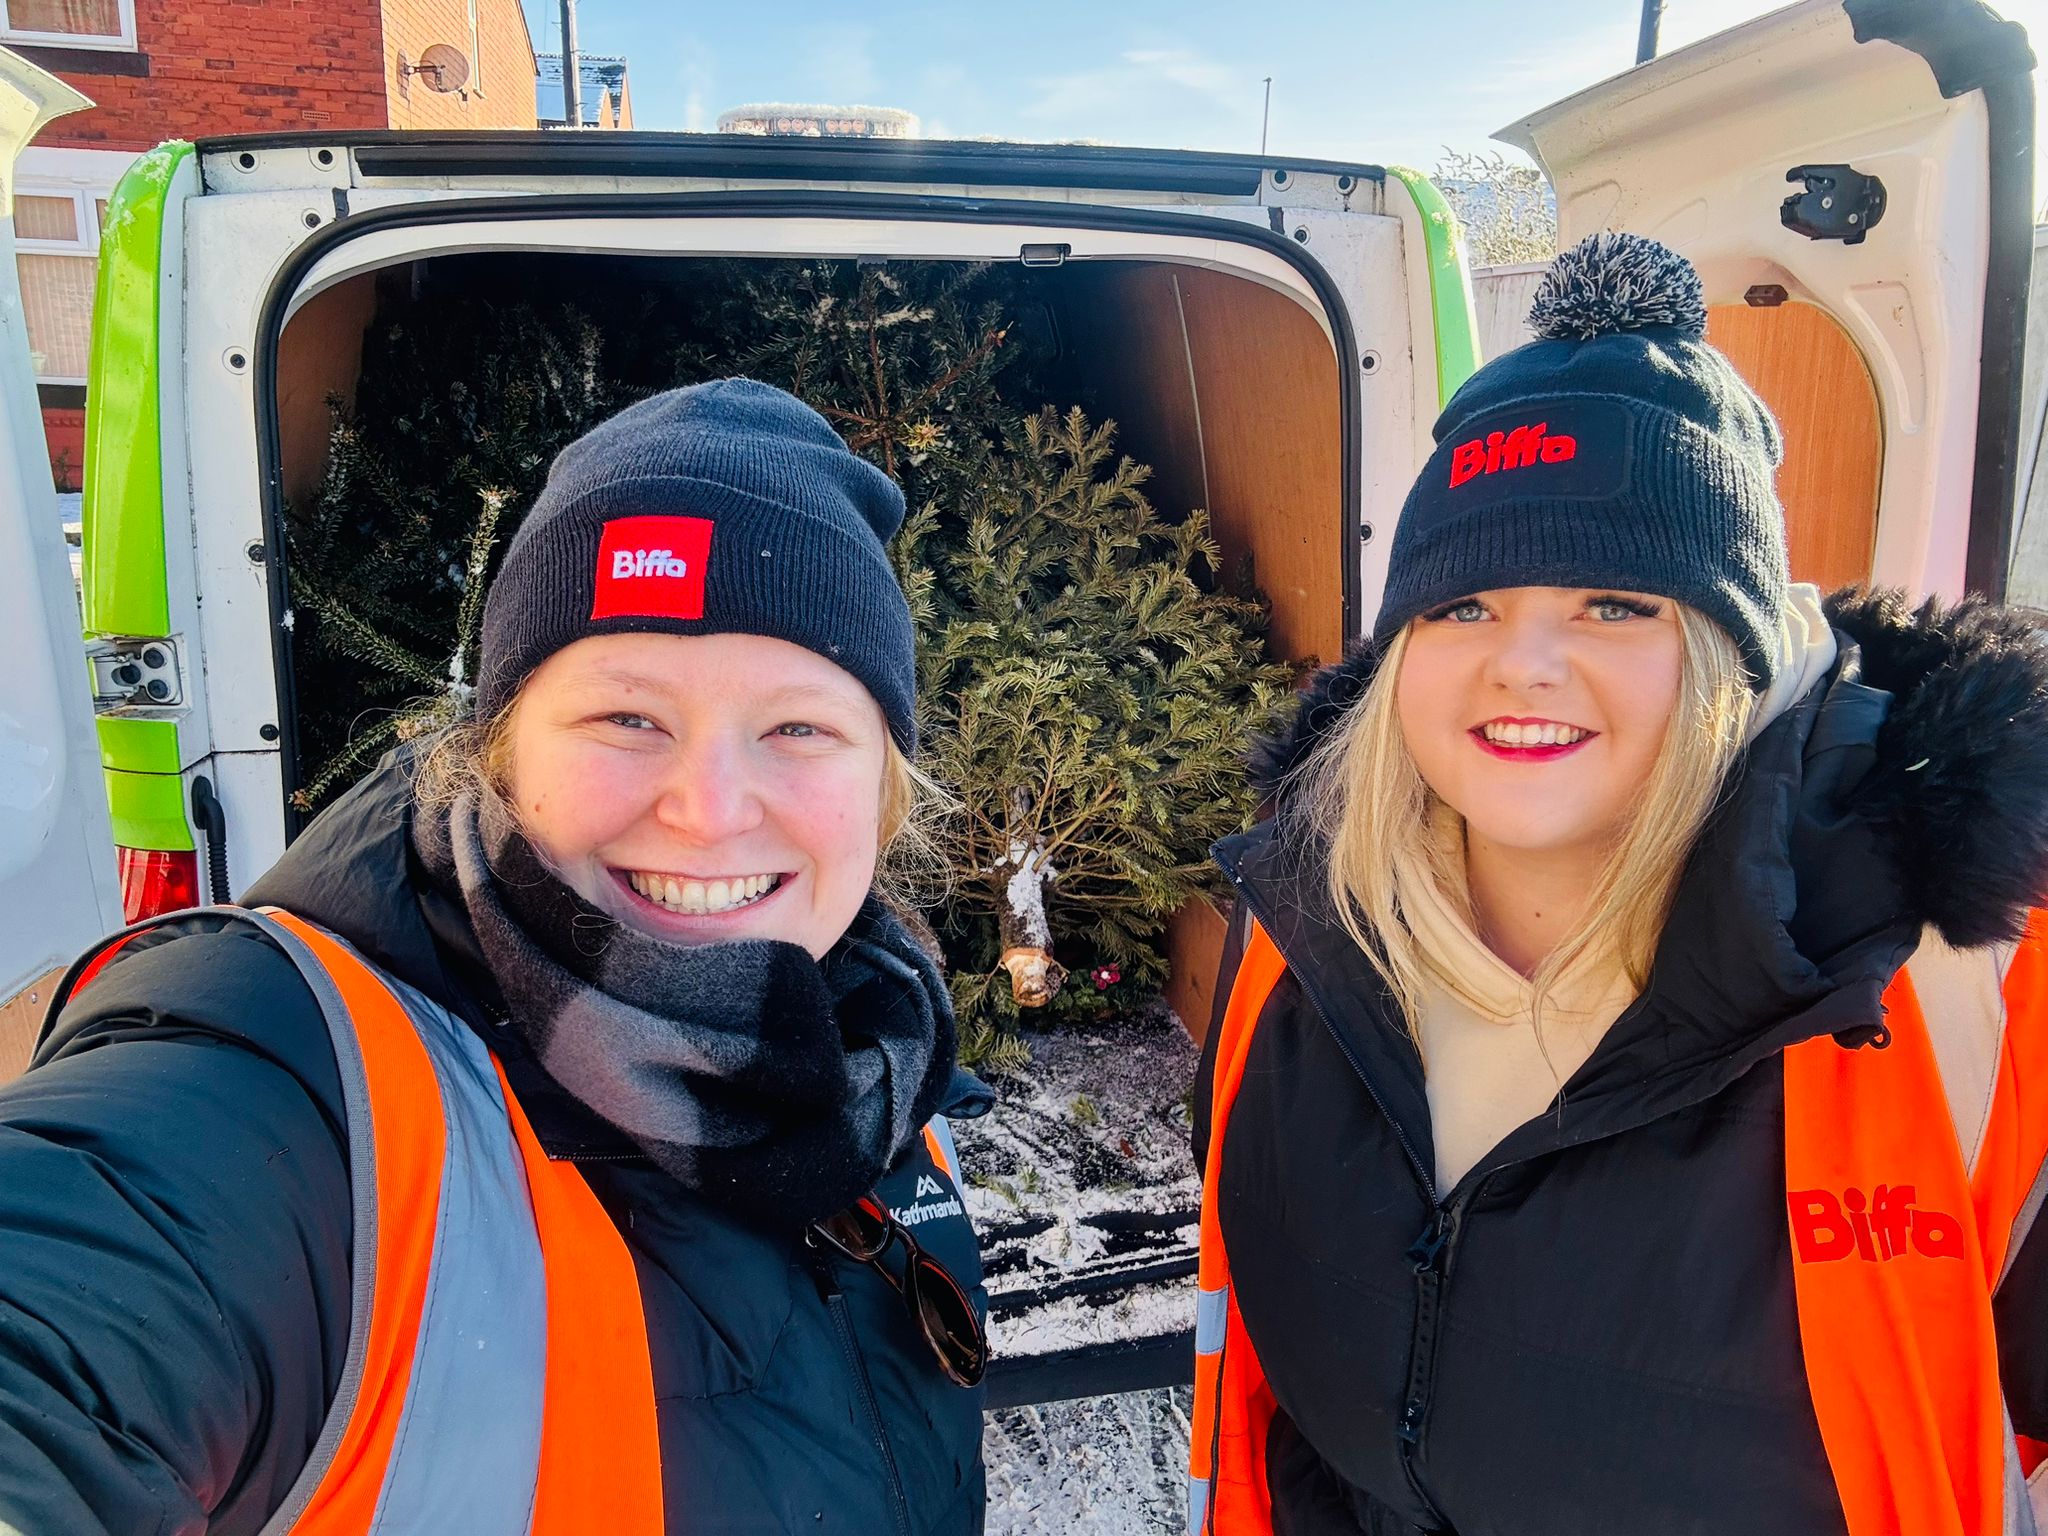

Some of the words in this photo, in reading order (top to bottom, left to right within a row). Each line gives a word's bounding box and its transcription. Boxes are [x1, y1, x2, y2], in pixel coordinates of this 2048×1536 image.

[1449, 422, 1577, 488] Biffa
[612, 549, 687, 579] Biffa
[1788, 1184, 1965, 1264] Biffa
